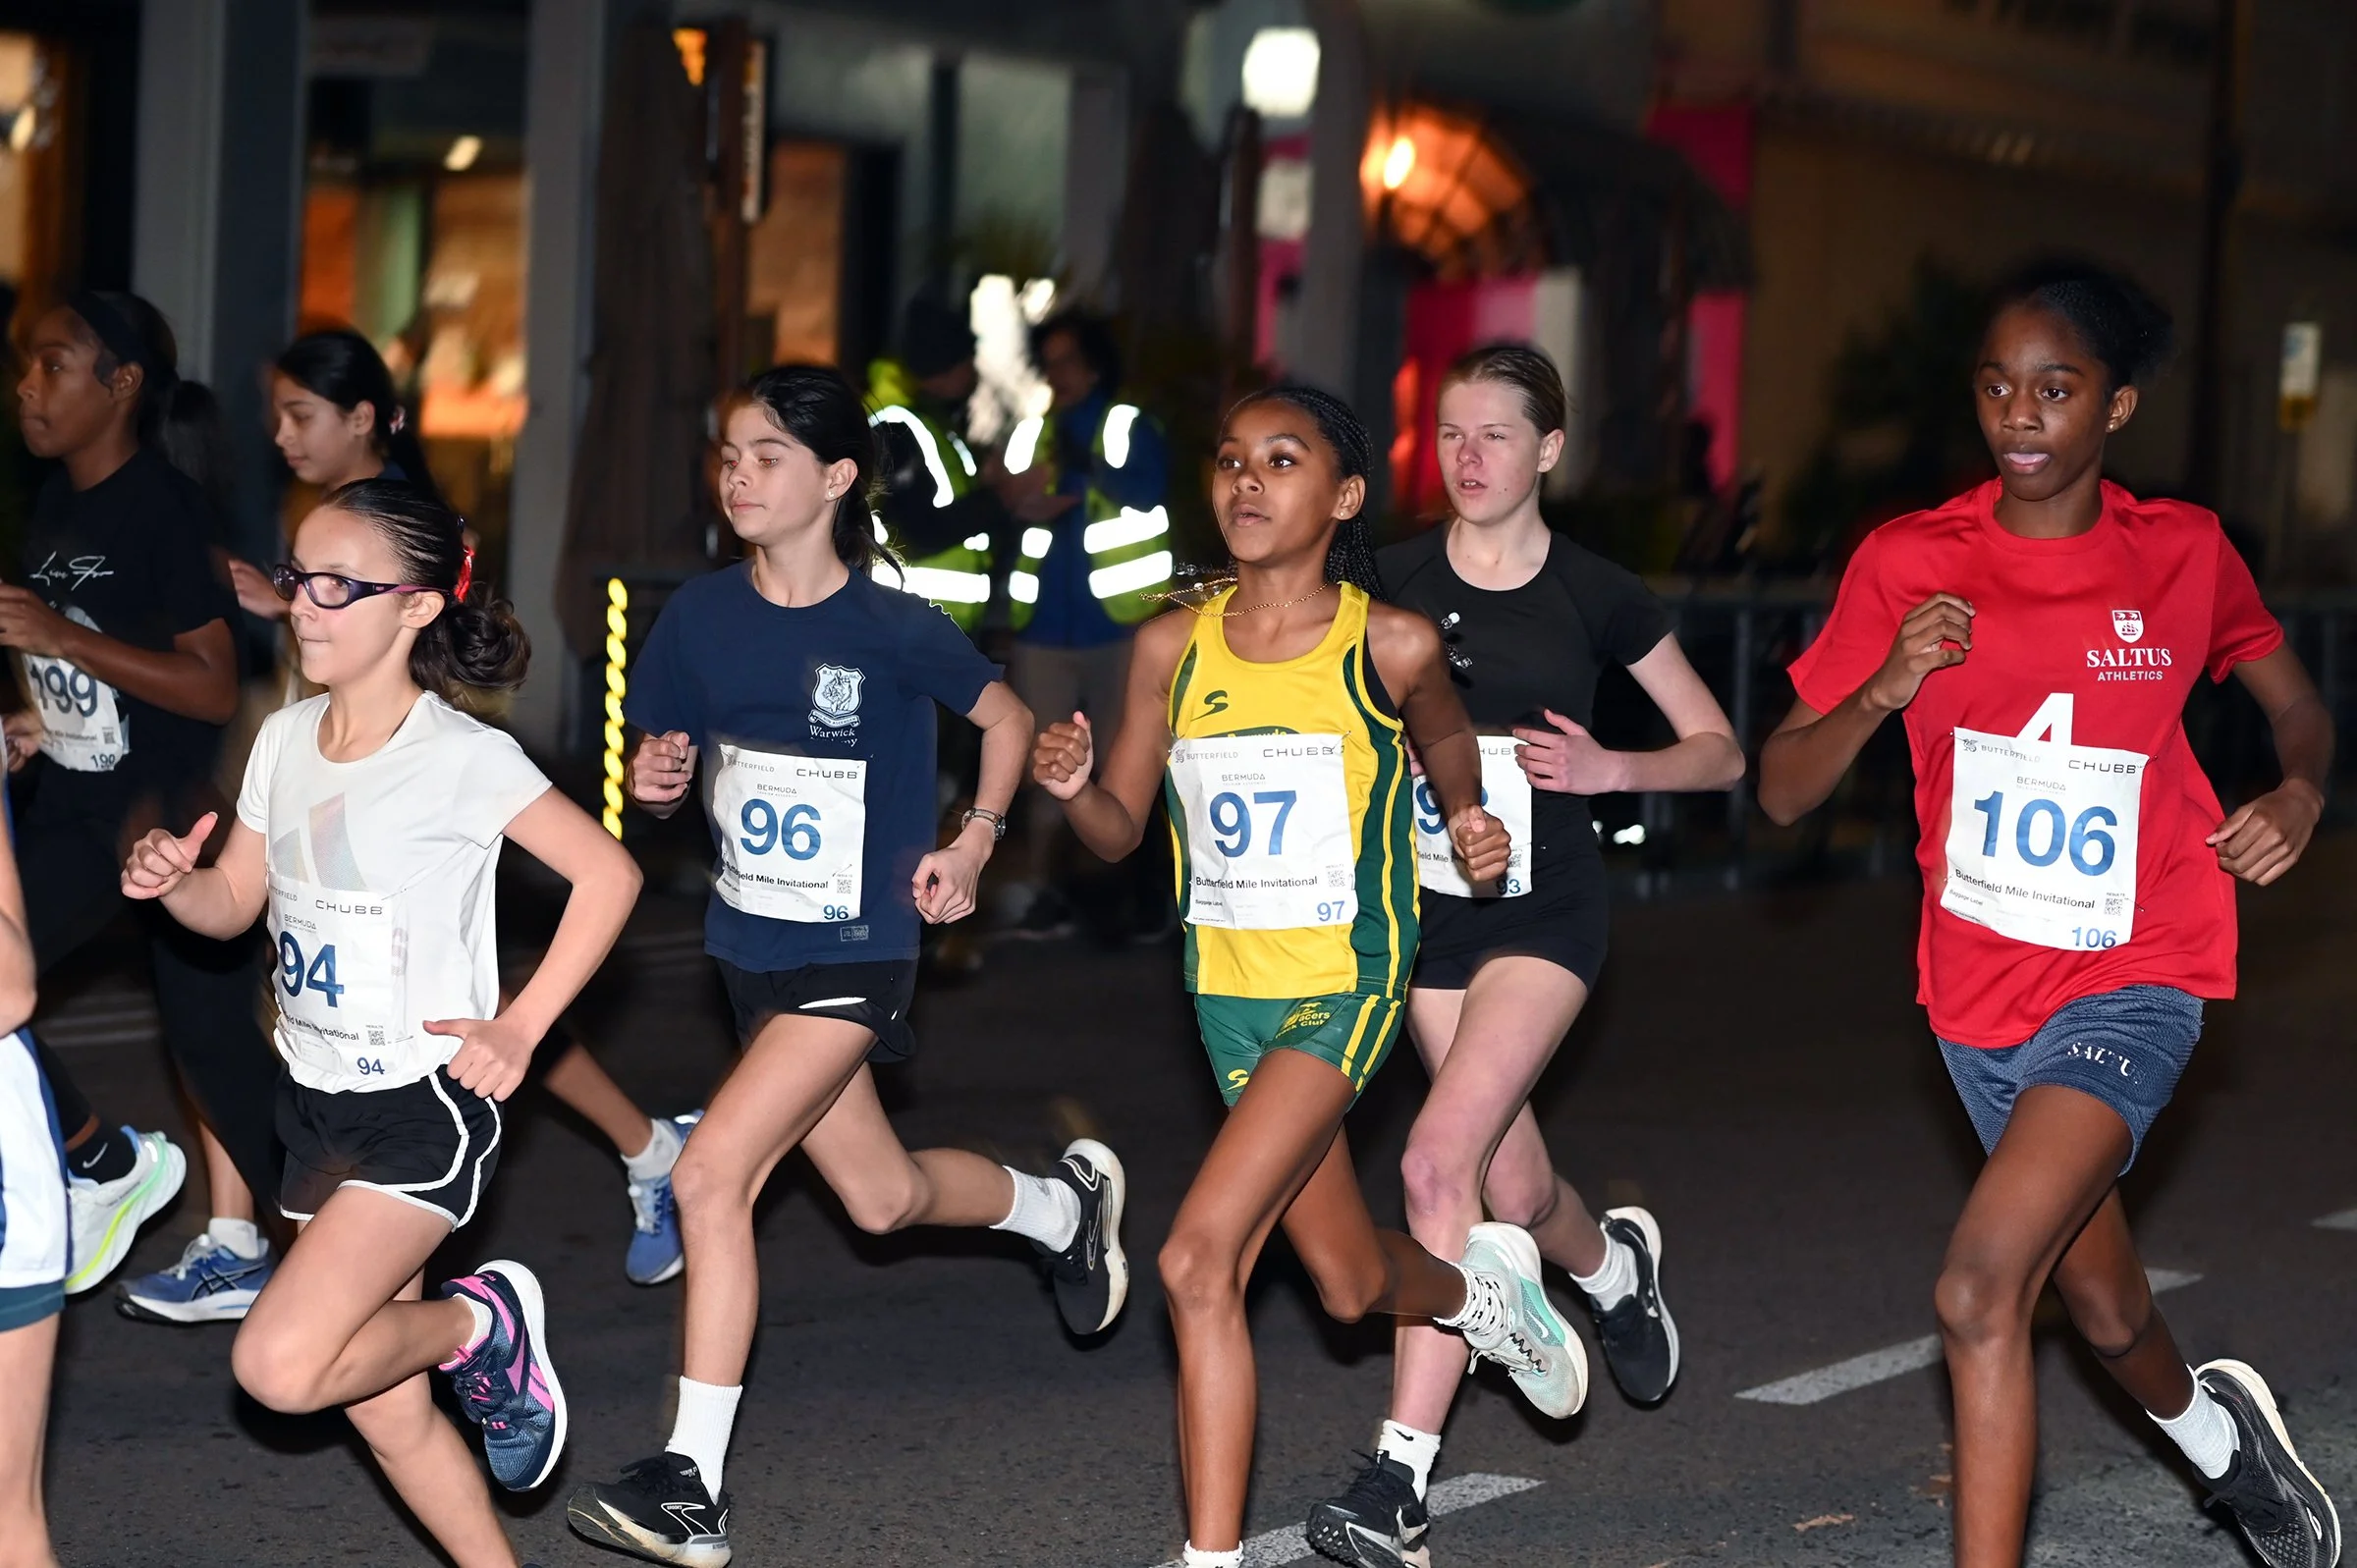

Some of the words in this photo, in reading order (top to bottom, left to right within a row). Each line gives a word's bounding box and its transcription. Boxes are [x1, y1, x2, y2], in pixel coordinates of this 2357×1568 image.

[2086, 648, 2172, 668] SALTUS
[2097, 670, 2164, 681] ATHLETICS
[30, 664, 97, 717] 199
[809, 725, 855, 738] Warwick
[1186, 751, 1238, 760] BUTTERFIELD
[1263, 746, 1334, 758] CHUBB
[1981, 744, 2041, 763] BUTTERFIELD
[737, 761, 775, 773] TTERFIELD
[796, 769, 857, 779] CHUBB
[2068, 760, 2137, 774] CHUBB
[1222, 773, 1266, 782] BERMUDA
[2016, 776, 2066, 791] BERMUDA
[757, 784, 797, 794] BERMUDA
[1415, 782, 1489, 835] 9
[740, 798, 821, 860] 96
[1210, 789, 1297, 858] 97
[1974, 790, 2117, 877] 106
[1433, 853, 1449, 862] Mile
[755, 874, 775, 885] Mile
[777, 877, 829, 889] Invitational
[1195, 876, 1233, 889] Butterfield
[1235, 880, 1257, 889] Mile
[1260, 876, 1318, 888] Invitational
[1495, 879, 1521, 895] 93
[1955, 869, 2002, 893] Butterfield
[2004, 886, 2029, 898] Mile
[2032, 891, 2095, 909] Invitational
[315, 899, 382, 915] CHUBB
[823, 904, 850, 920] 96
[1317, 900, 1345, 922] 97
[284, 913, 317, 930] BERMUDA
[2071, 926, 2117, 948] 106
[280, 931, 344, 1007] 94
[356, 1056, 385, 1075] 94
